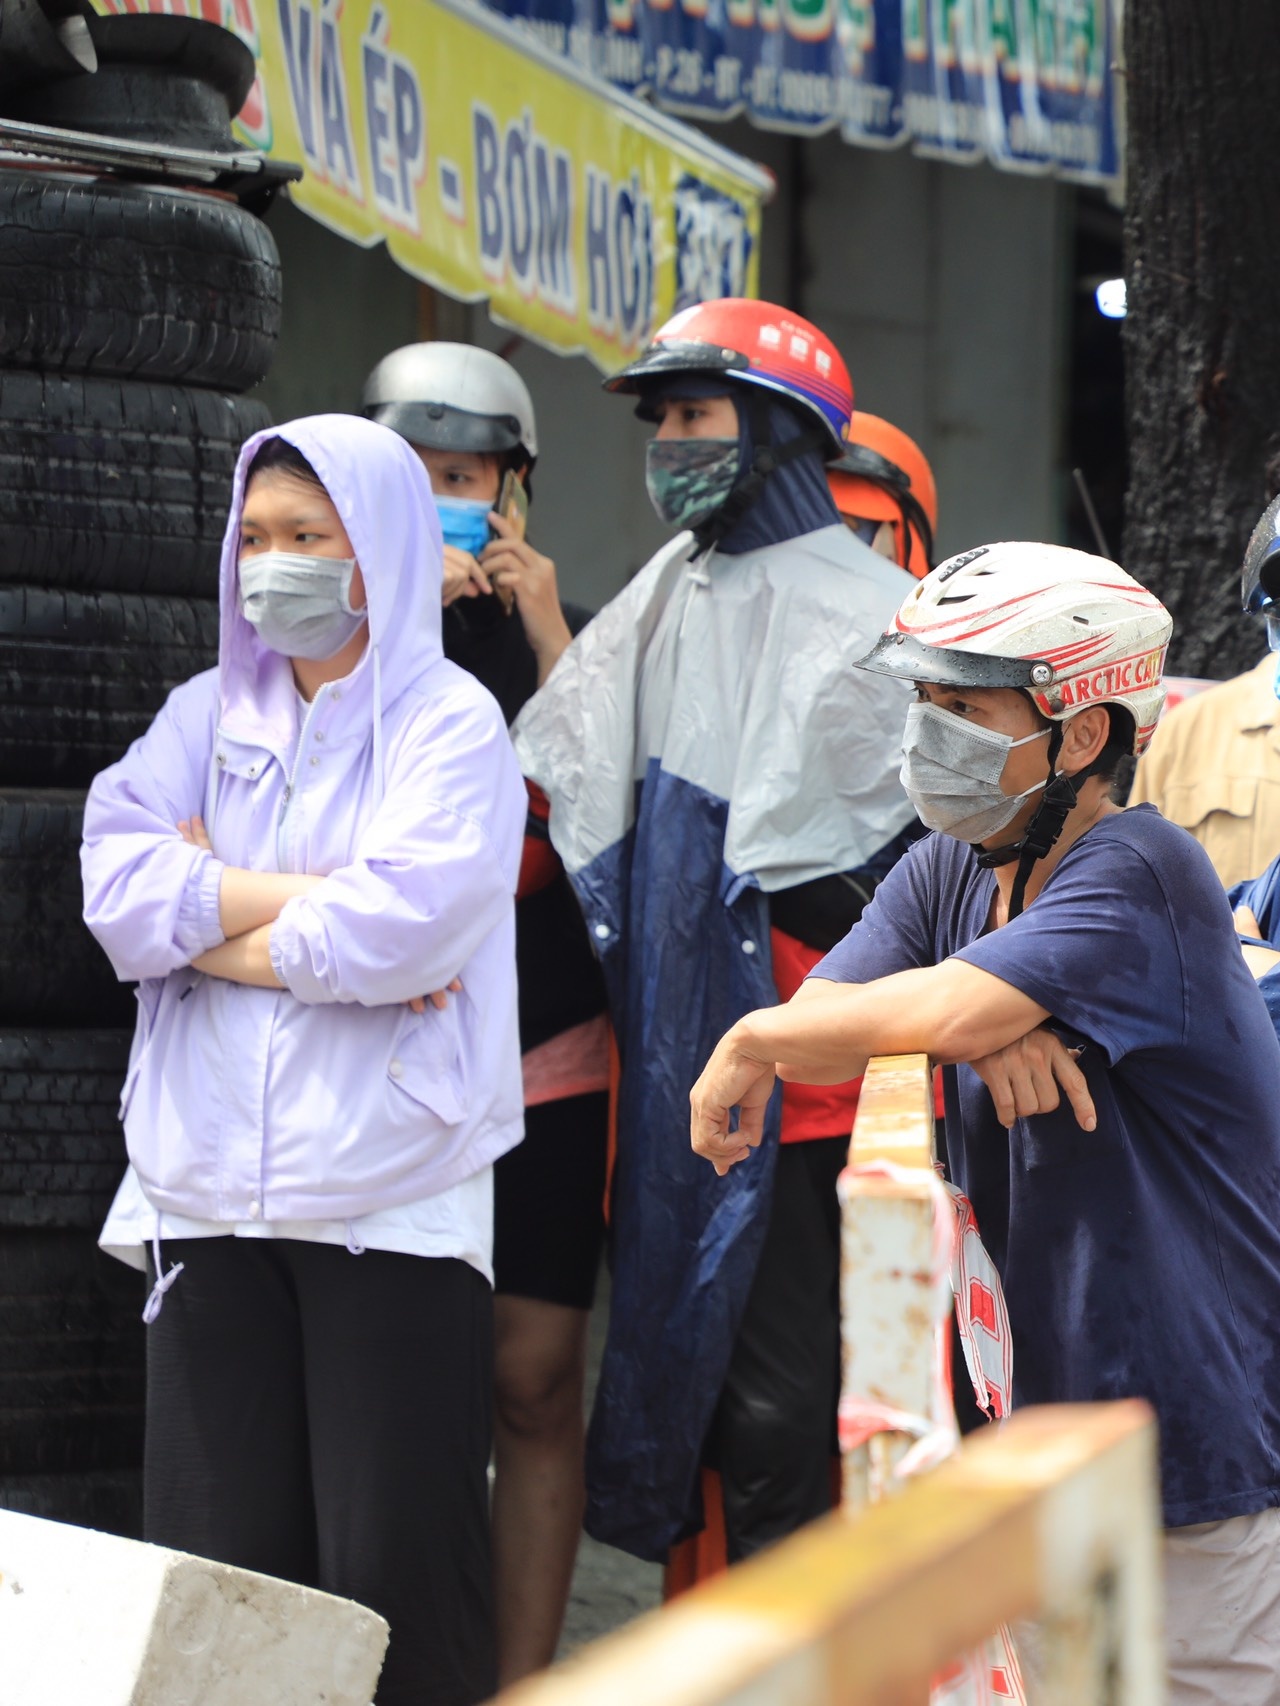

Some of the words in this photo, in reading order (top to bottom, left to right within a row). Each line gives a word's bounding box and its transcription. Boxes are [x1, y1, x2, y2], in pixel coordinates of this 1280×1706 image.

[363, 9, 424, 216] ÉP
[473, 104, 574, 306] BƠM
[1060, 662, 1132, 706] ARCTIC
